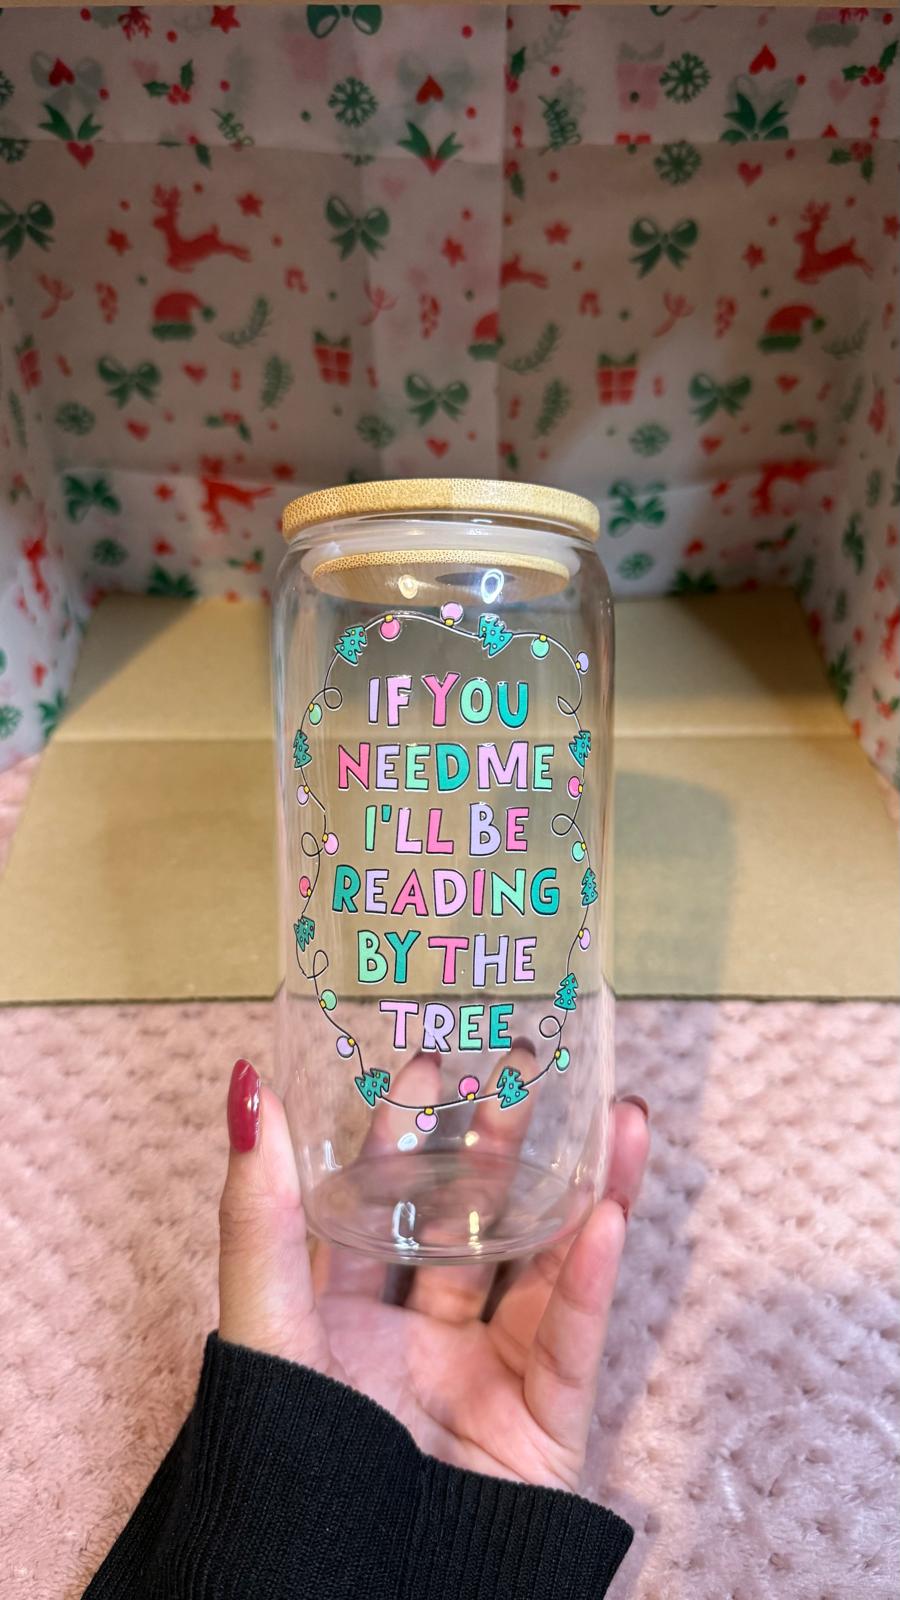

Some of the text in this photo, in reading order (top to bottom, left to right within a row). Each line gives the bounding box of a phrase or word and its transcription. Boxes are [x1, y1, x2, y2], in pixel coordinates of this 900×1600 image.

[368, 672, 528, 728] IF YOU
[338, 741, 555, 792] NEED ME
[364, 802, 529, 856] I'LL BE
[332, 865, 560, 916] READING
[357, 930, 537, 987] BY THE
[379, 1001, 514, 1052] TREE
